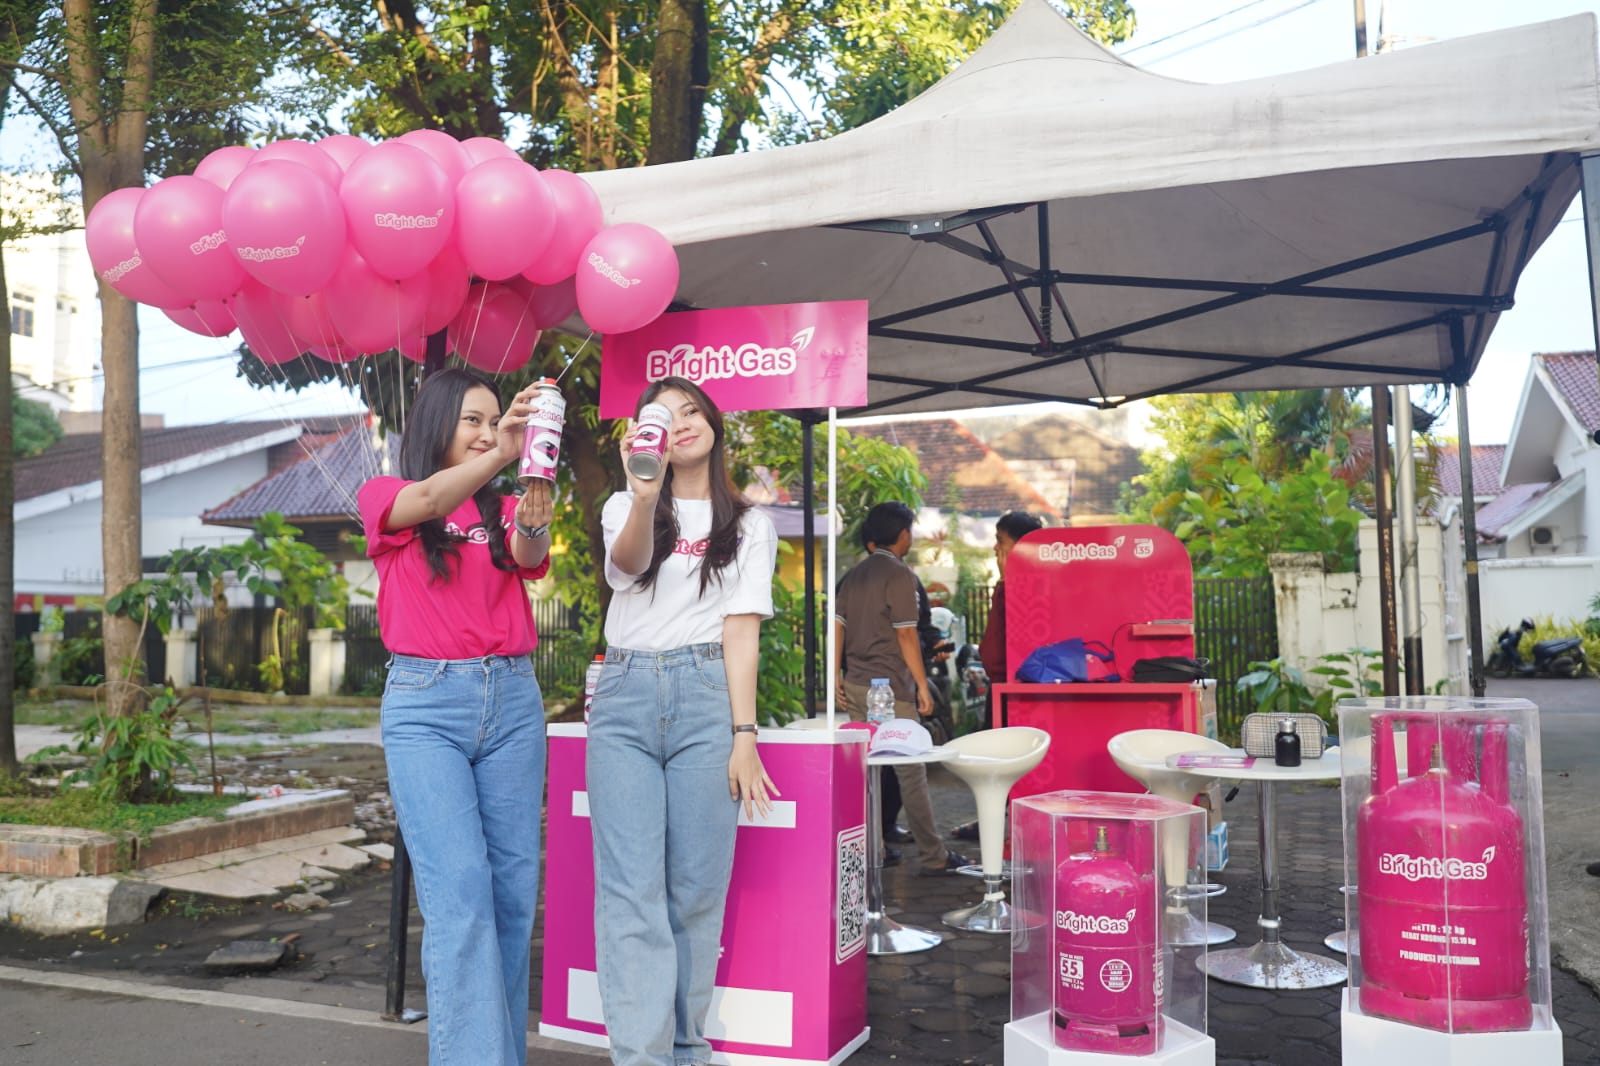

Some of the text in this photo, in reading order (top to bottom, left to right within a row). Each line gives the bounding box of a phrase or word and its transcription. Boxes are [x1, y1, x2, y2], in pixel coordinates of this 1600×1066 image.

[375, 213, 438, 230] Bright Gas
[273, 246, 300, 259] Gas
[648, 343, 796, 384] Bright Gas
[1040, 542, 1117, 563] Bright Gas
[1379, 853, 1487, 881] Bright Gas
[1056, 910, 1128, 934] Bright Gas
